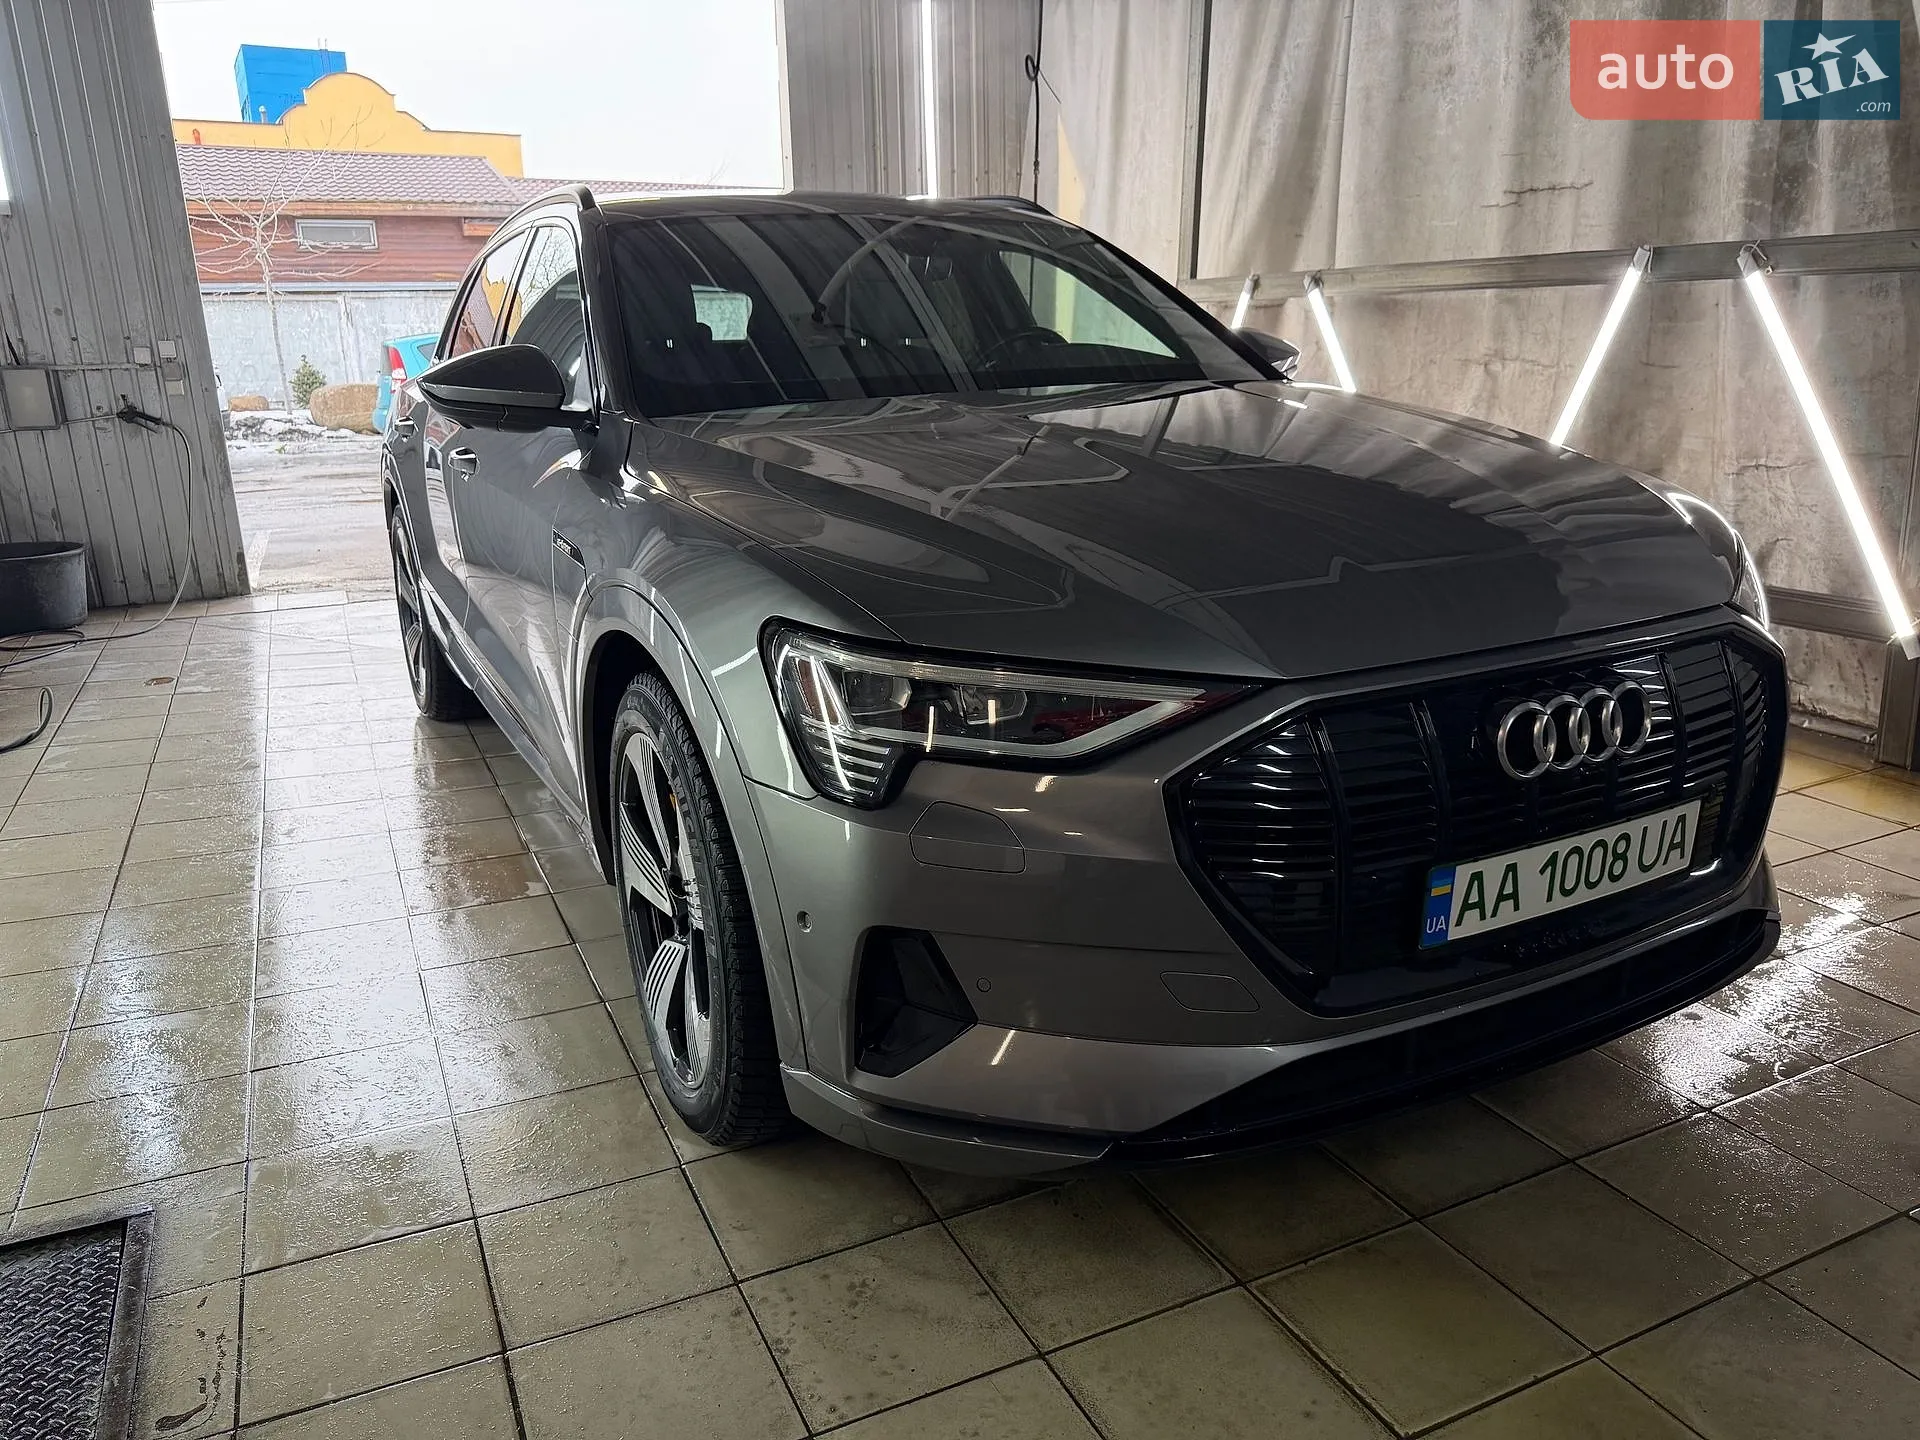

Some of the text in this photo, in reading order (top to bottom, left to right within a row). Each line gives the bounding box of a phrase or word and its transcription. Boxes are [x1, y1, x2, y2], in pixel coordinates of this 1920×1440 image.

[1455, 813, 1687, 928] AA 1008 UA
[1426, 915, 1446, 933] UA
